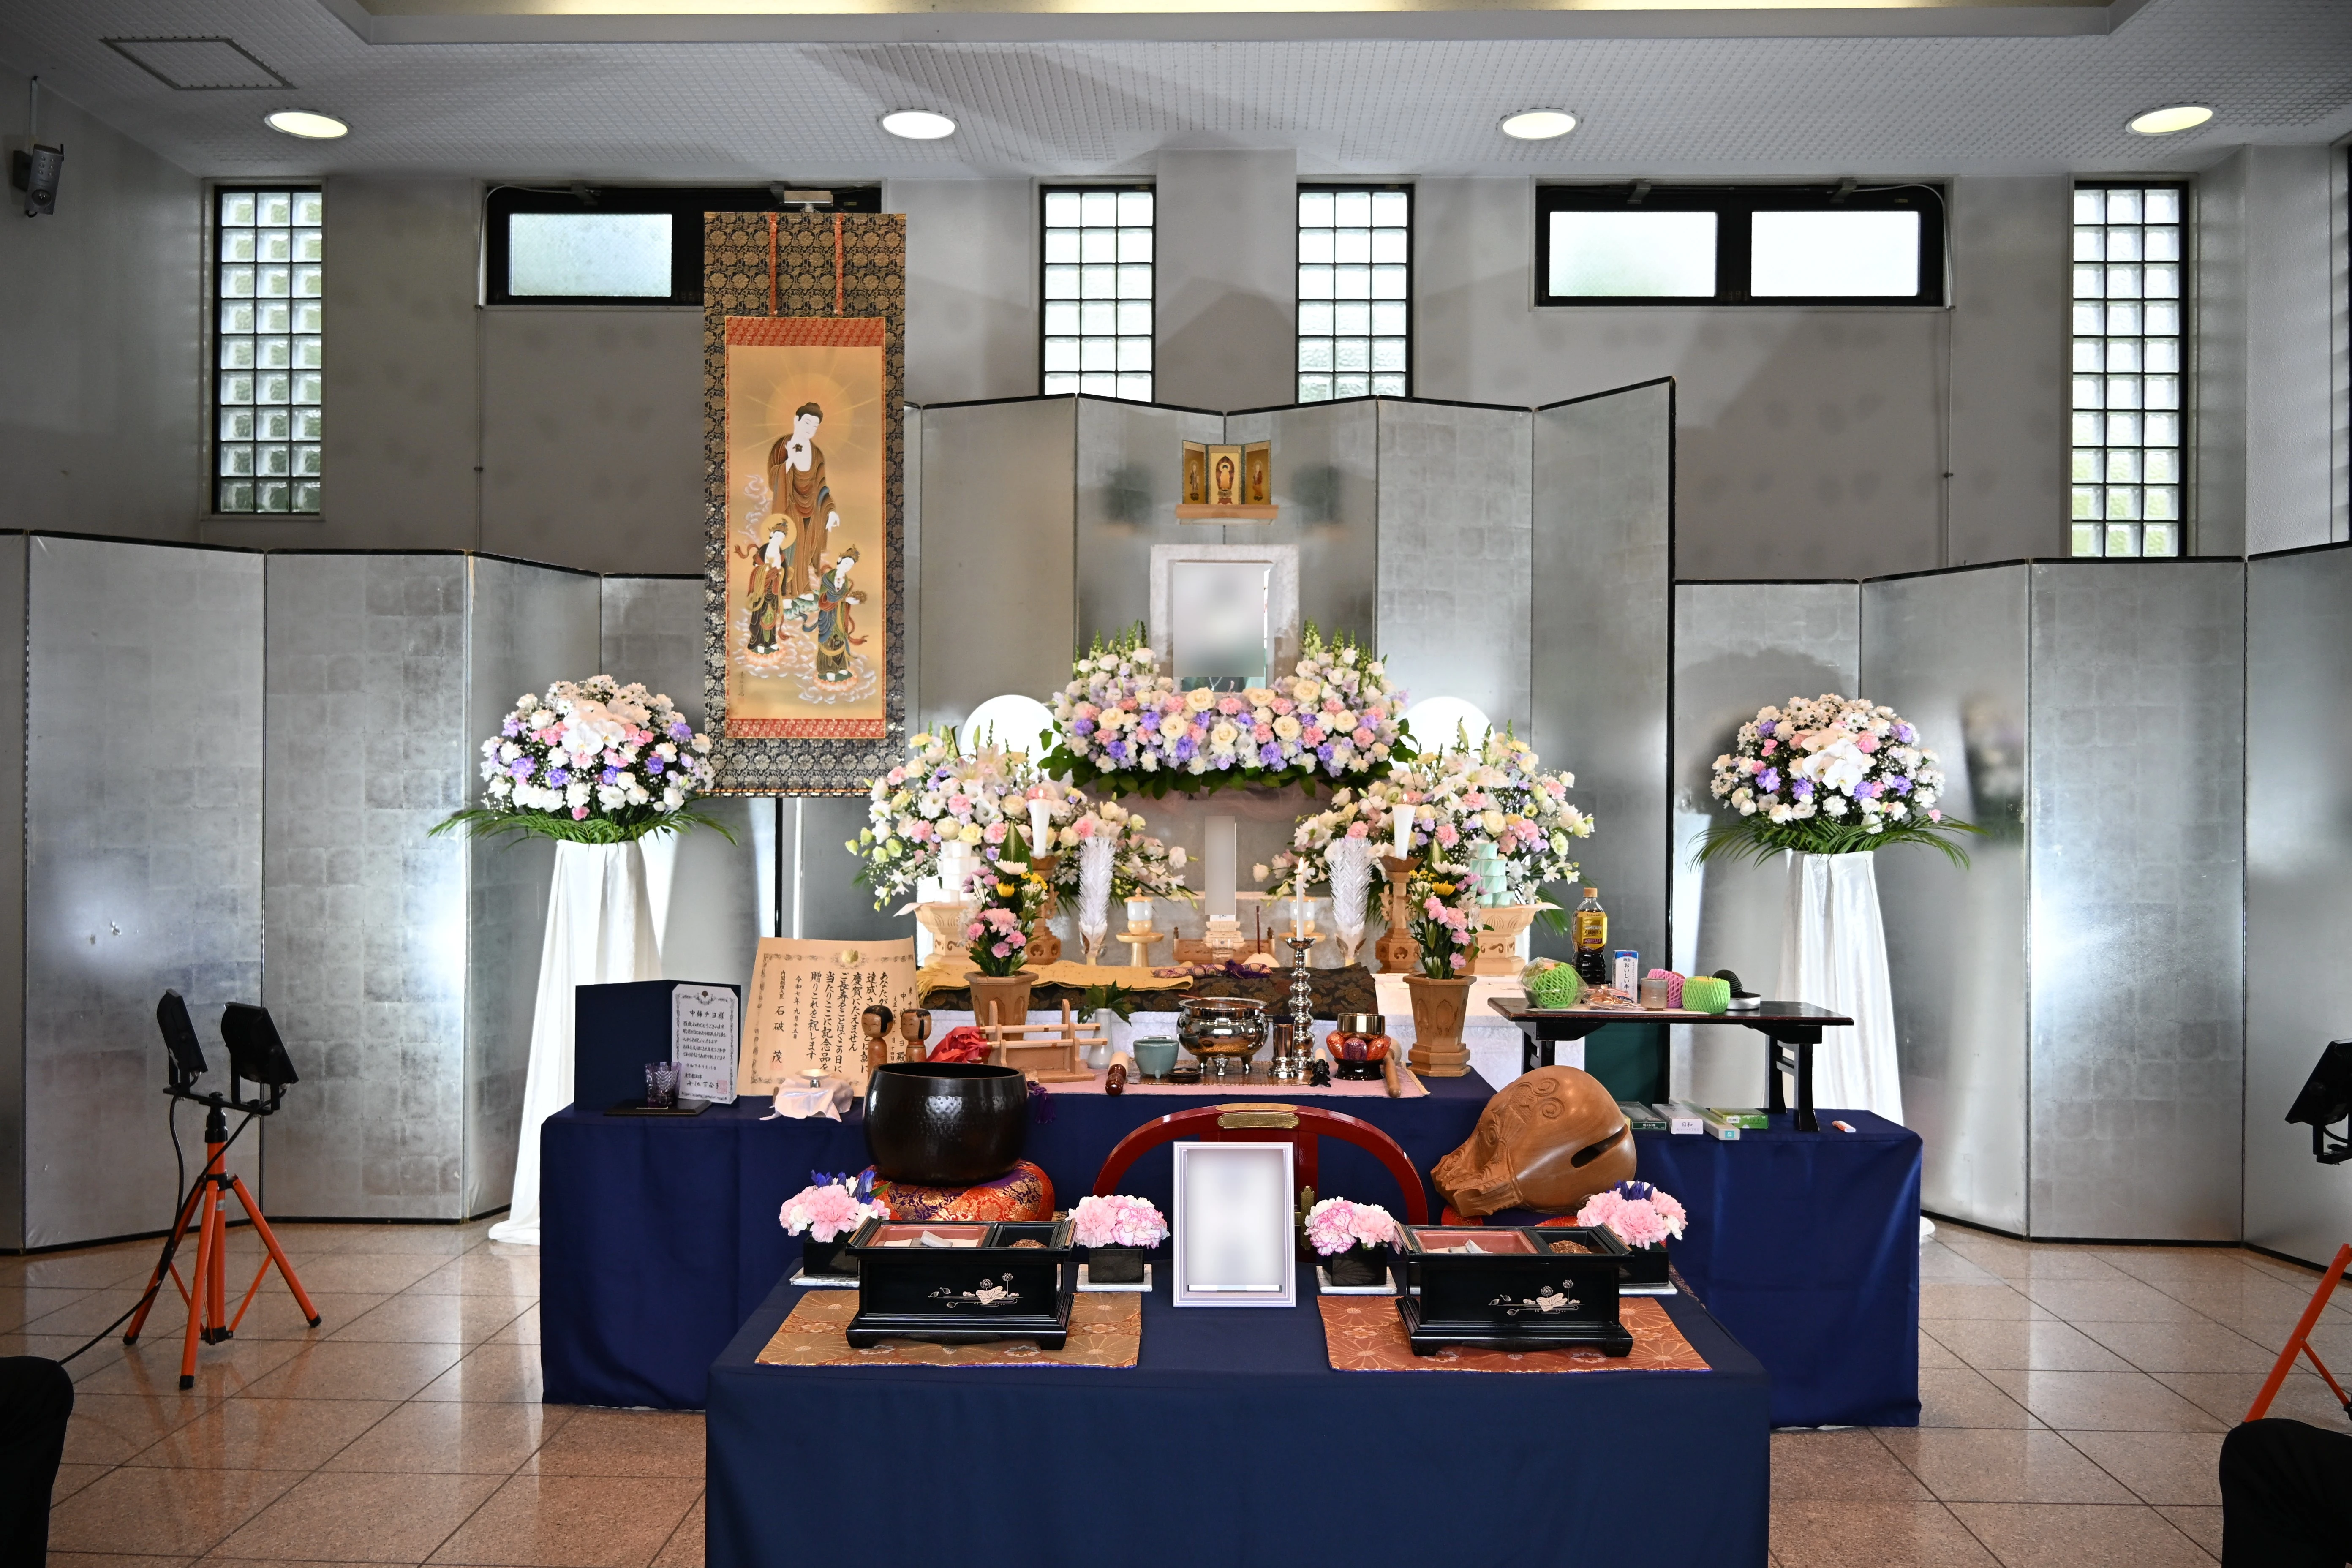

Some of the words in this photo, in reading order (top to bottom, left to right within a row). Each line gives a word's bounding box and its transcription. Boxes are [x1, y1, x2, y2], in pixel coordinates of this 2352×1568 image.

[792, 975, 803, 1039] 令和七年九月十五日
[806, 971, 822, 1061] 贈りこれを祝します
[819, 971, 835, 1070] 当たりここに記念品を
[834, 972, 849, 1073] ご長寿をことほぐこの日に
[848, 972, 863, 1052] 慶賀にたえません
